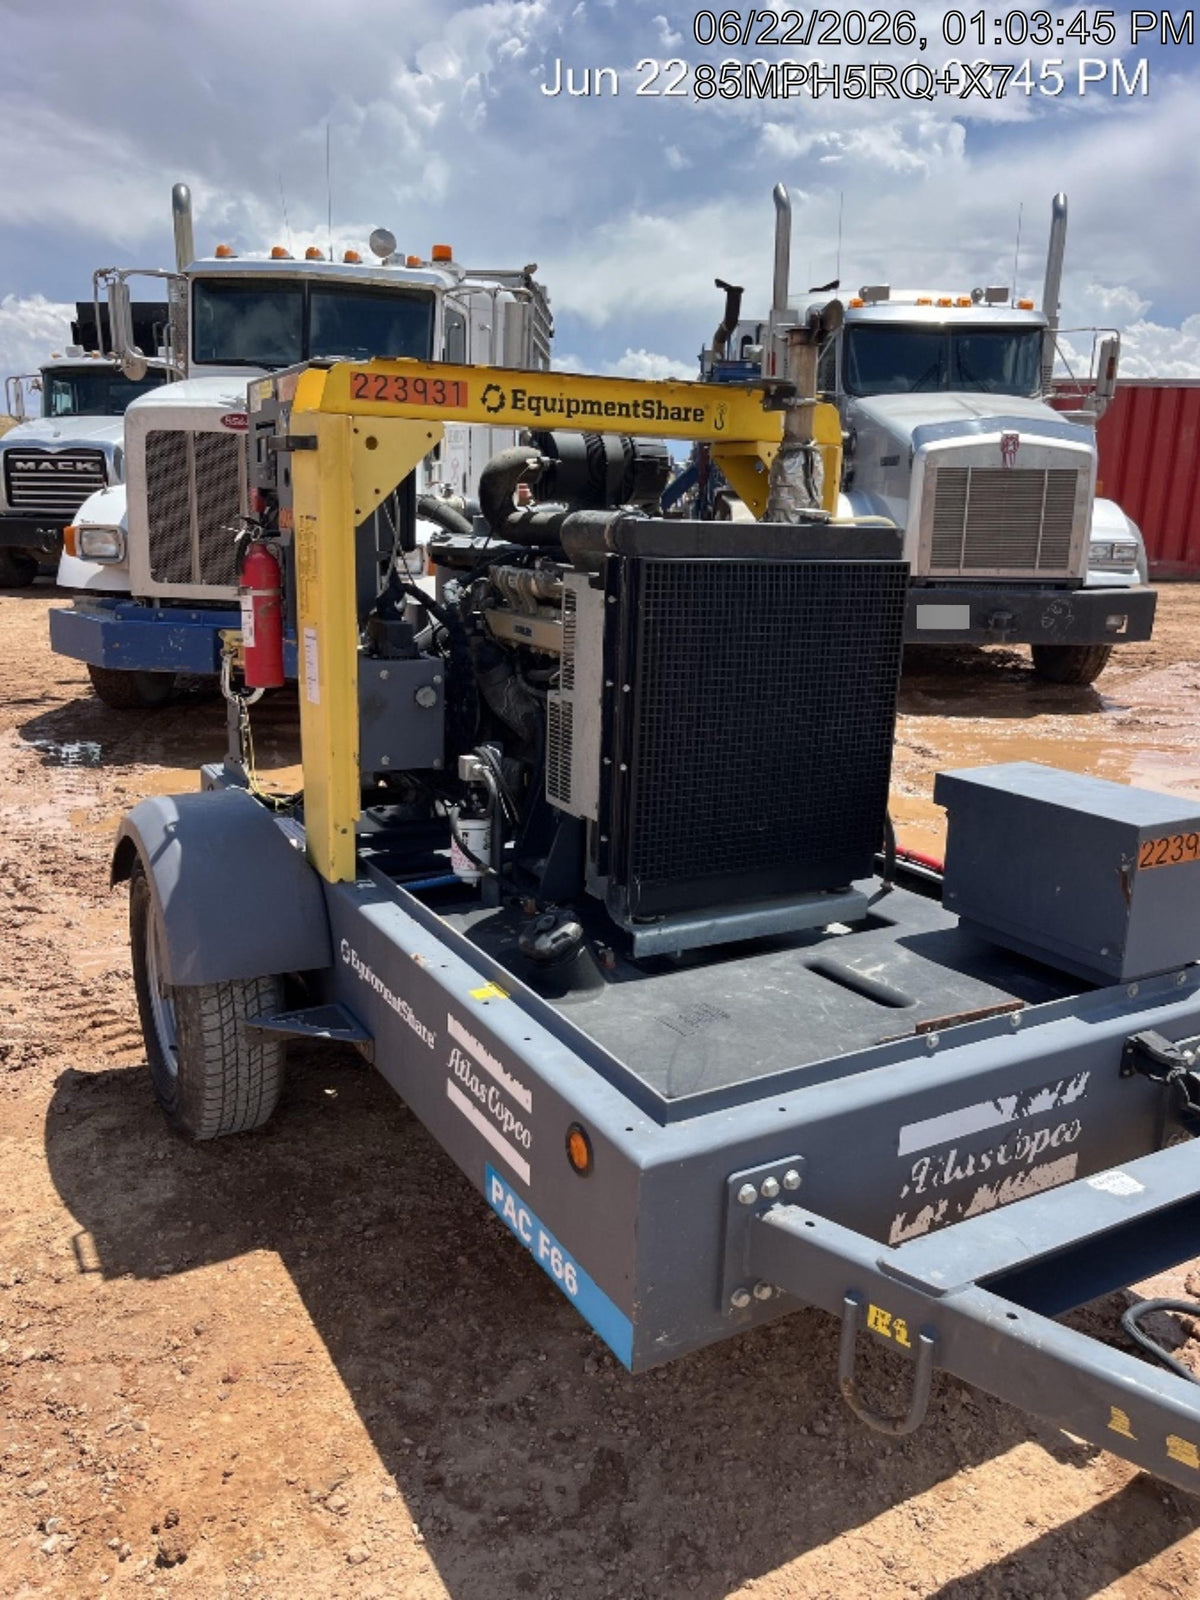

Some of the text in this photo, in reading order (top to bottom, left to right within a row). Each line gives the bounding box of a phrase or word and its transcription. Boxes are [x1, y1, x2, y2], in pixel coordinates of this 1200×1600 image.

[354, 373, 461, 406] 223931
[510, 389, 706, 422] EquipmentShare
[15, 461, 100, 472] MACK
[1139, 833, 1200, 868] 2239
[491, 1174, 578, 1296] PAC F66
